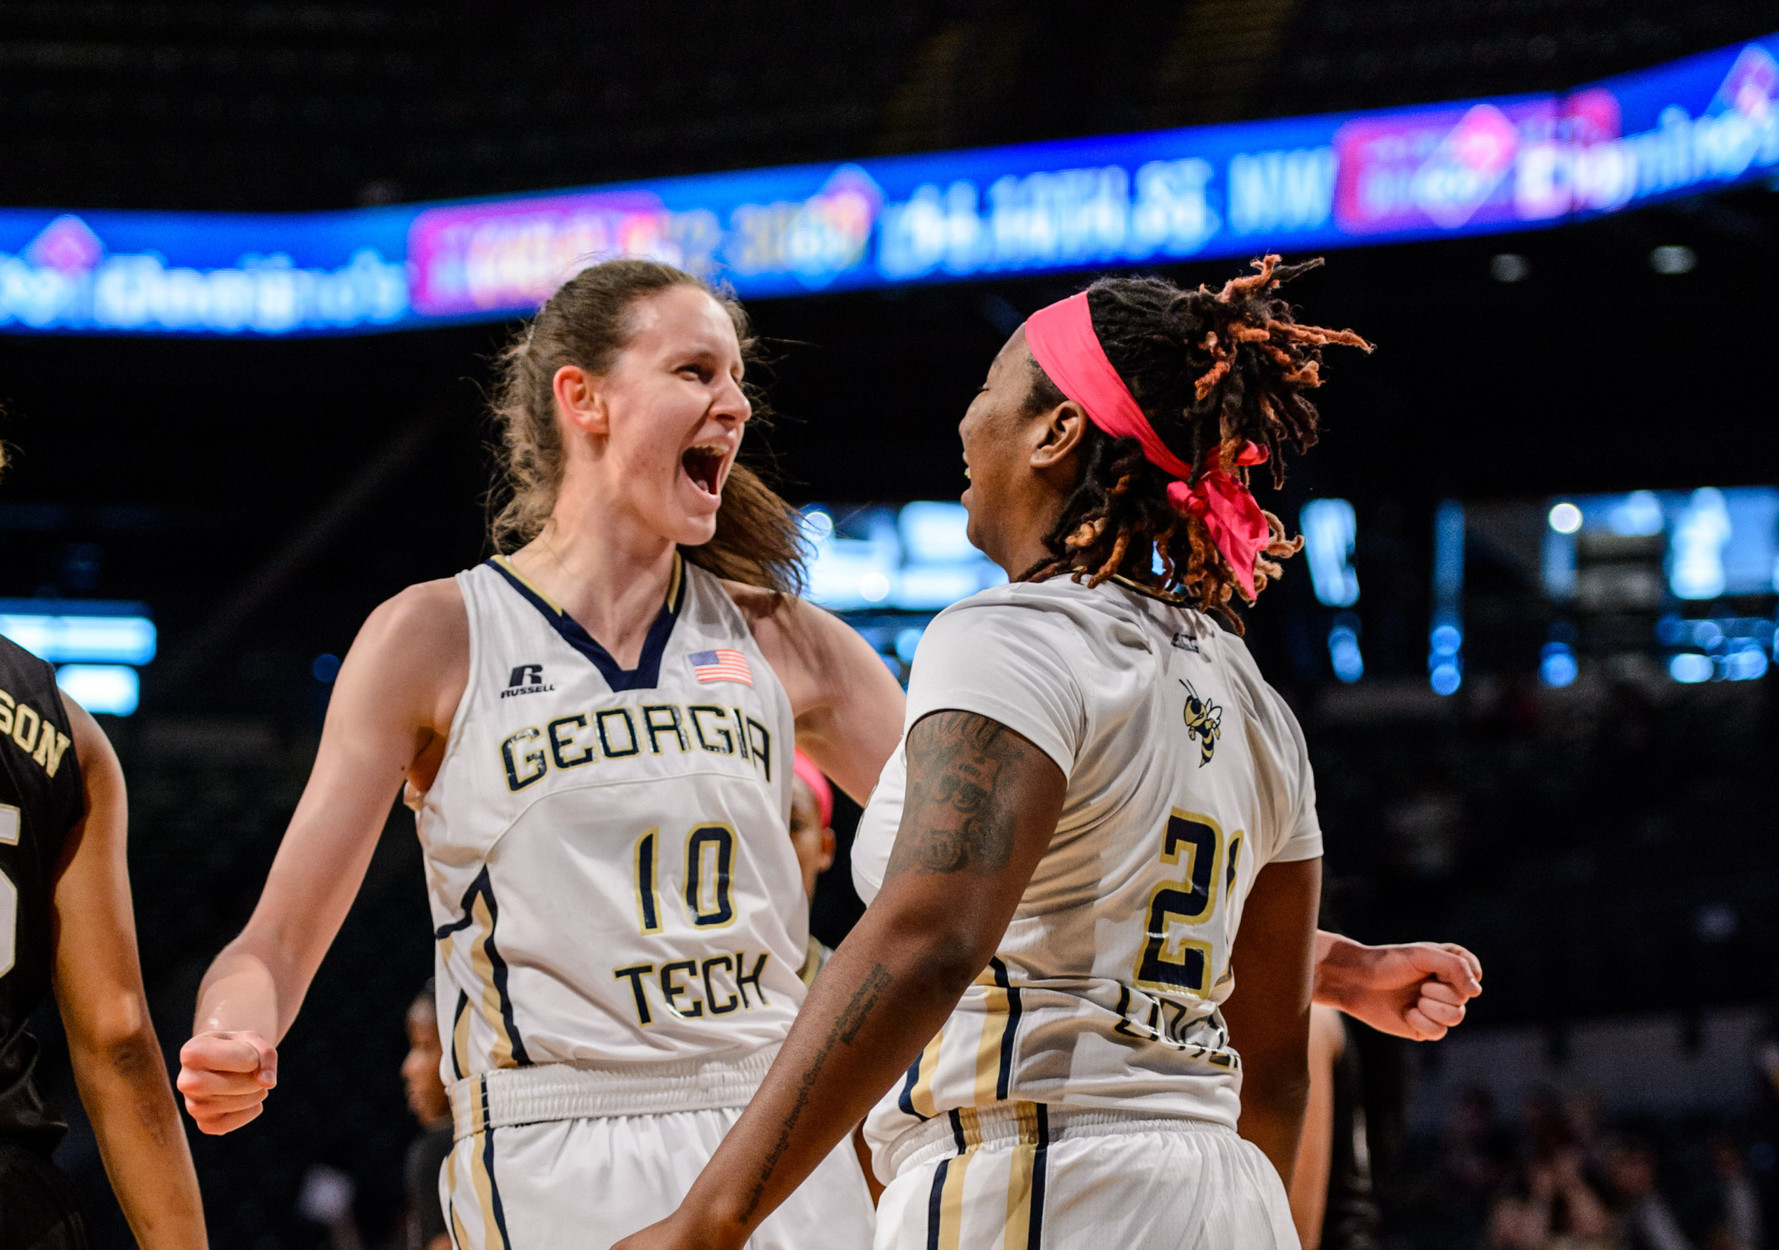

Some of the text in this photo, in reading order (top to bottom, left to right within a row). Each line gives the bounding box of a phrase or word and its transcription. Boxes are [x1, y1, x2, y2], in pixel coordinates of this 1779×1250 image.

[501, 684, 556, 699] RUSSELL
[500, 704, 772, 793] GEORGIA
[634, 820, 737, 935] 10
[613, 951, 770, 1027] TECH
